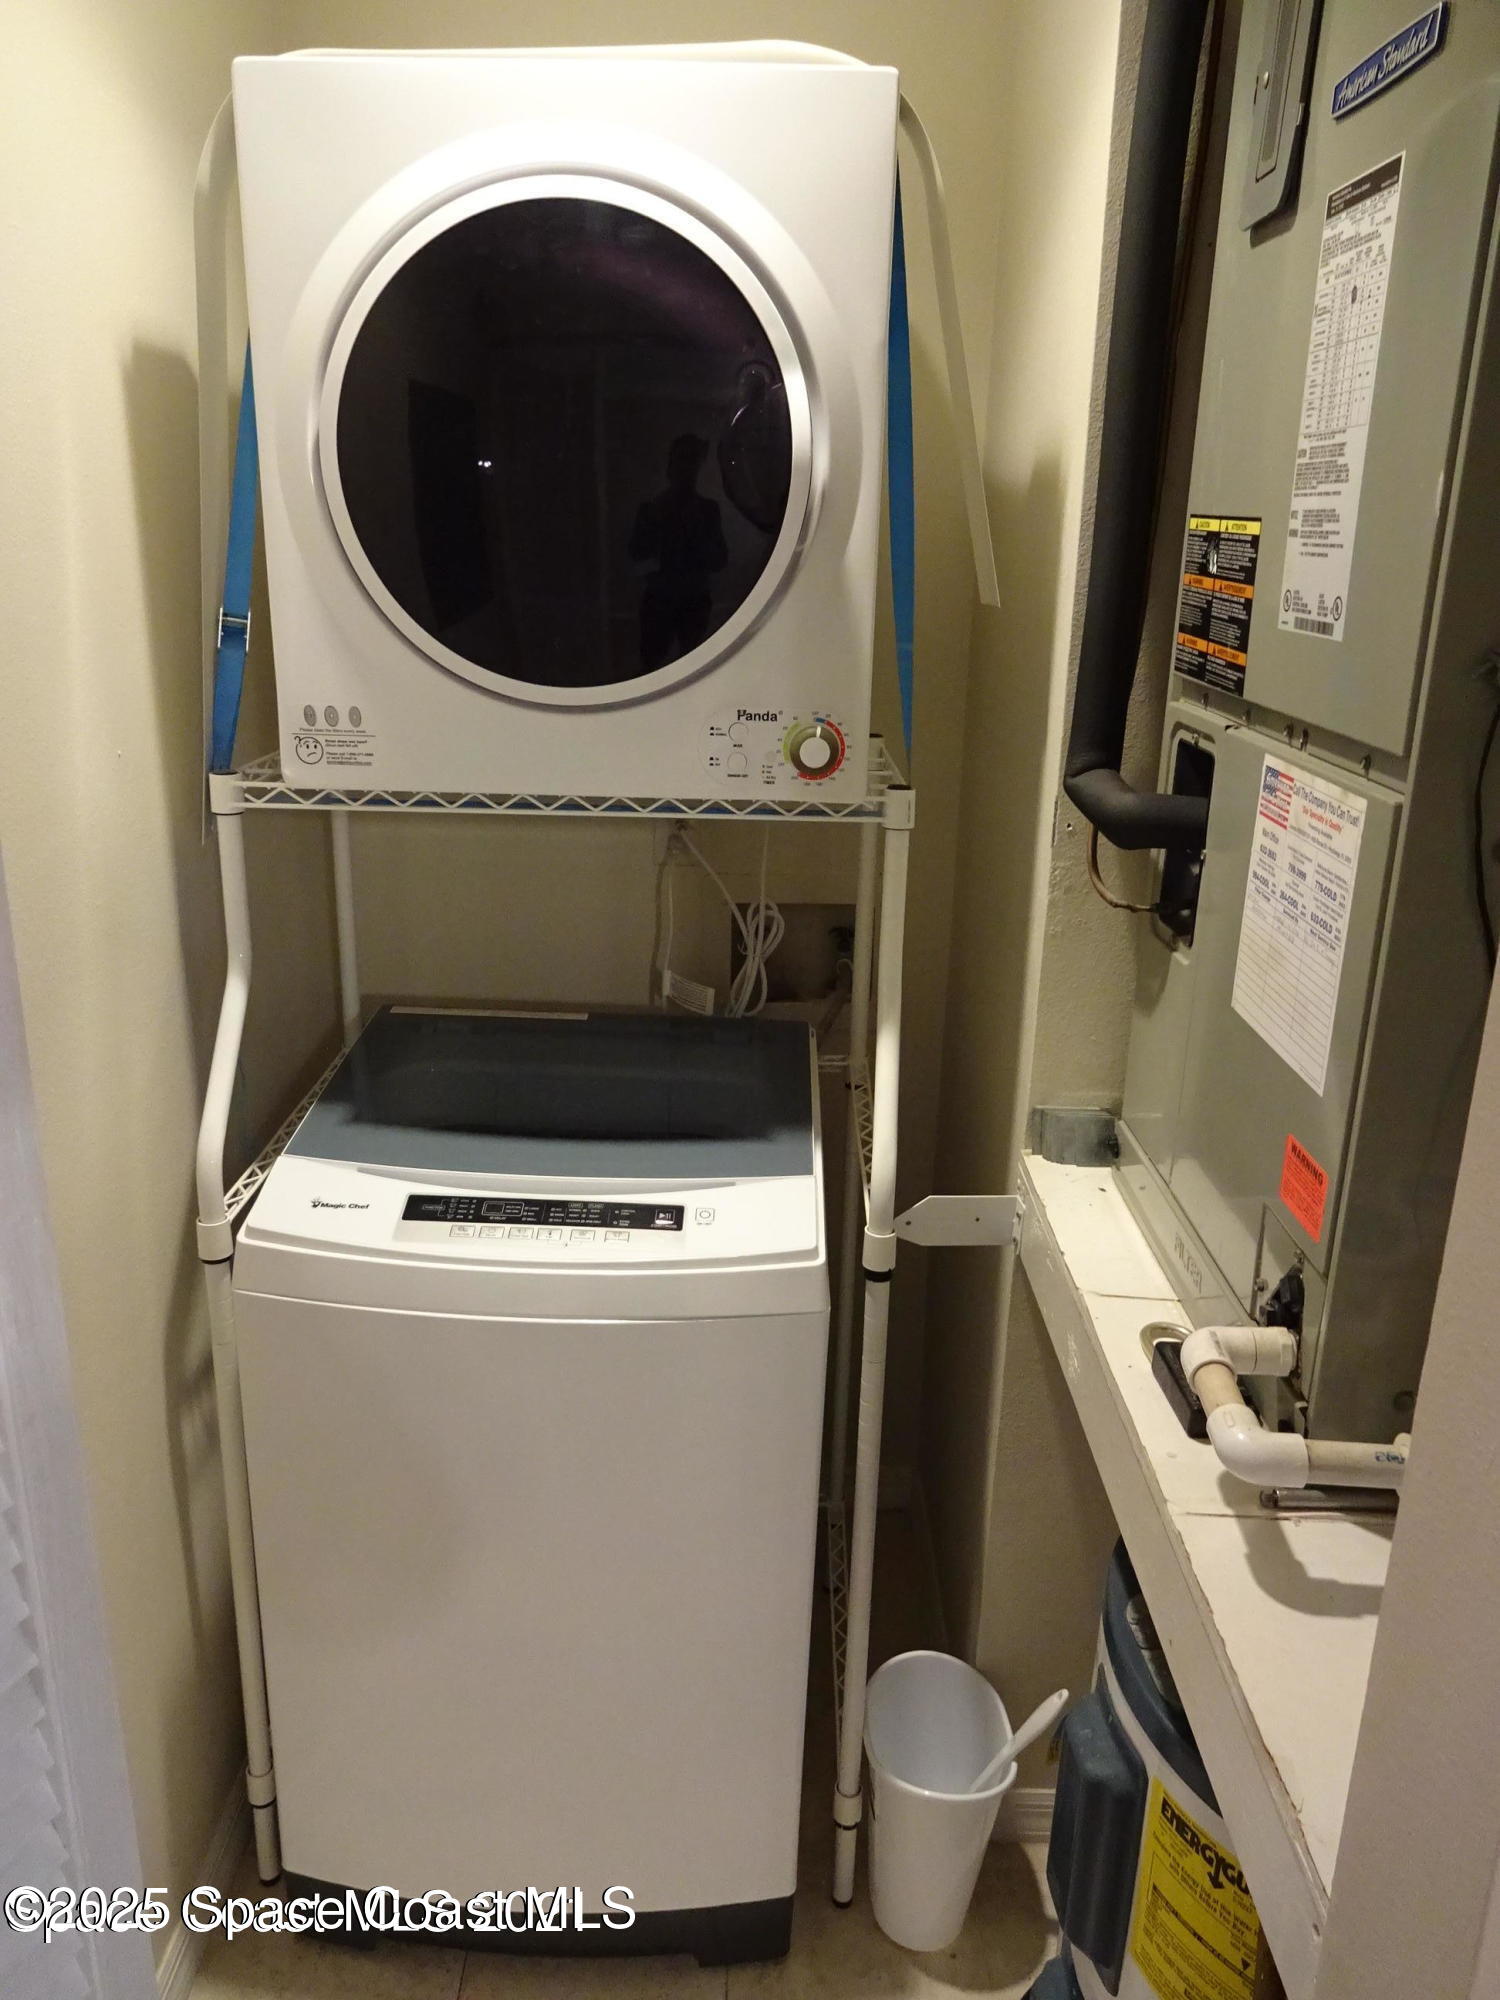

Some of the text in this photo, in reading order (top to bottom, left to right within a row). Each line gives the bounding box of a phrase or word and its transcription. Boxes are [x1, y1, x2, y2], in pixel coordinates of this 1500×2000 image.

[1336, 14, 1433, 110] American Standard
[737, 709, 778, 722] Panda
[1308, 790, 1328, 813] Company
[1328, 801, 1337, 816] You
[1337, 805, 1346, 820] Can
[1291, 1142, 1324, 1186] WARNING
